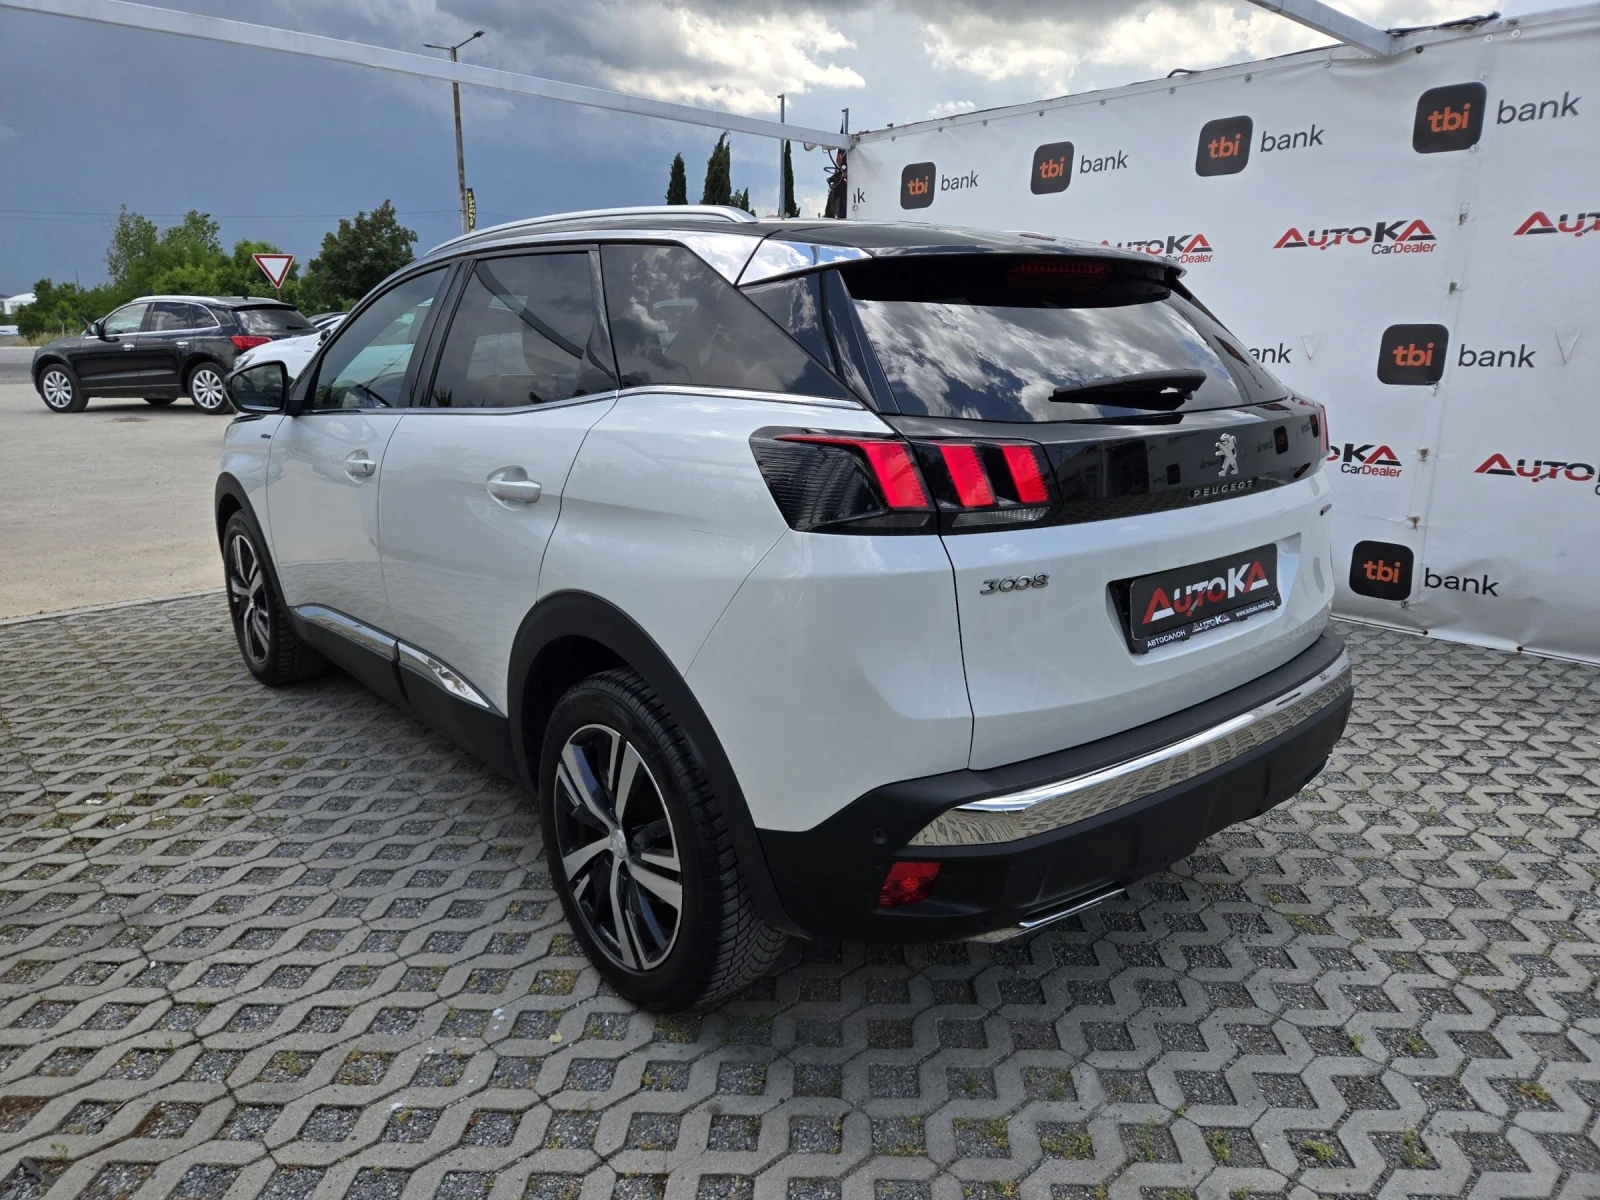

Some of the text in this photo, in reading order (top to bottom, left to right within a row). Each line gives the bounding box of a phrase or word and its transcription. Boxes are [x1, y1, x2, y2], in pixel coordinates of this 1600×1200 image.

[1428, 91, 1582, 132] tbi bank
[1208, 124, 1324, 159] tbi bank
[1040, 150, 1129, 179] tbi bank
[907, 170, 979, 195] tbi bank
[1272, 219, 1437, 250] AUTOKA
[1371, 242, 1437, 255] CarDealer
[1392, 341, 1537, 368] tbi bank
[1341, 463, 1403, 477] CarDealer
[1473, 453, 1600, 482] AUTO
[1194, 480, 1253, 499] PEUGEOT
[980, 572, 1050, 595] 3008
[1363, 560, 1499, 597] tbi bank
[1142, 561, 1269, 624] AUTOKA
[1192, 613, 1231, 633] AUTOKA
[1147, 629, 1186, 648] АВТОСАЛОН
